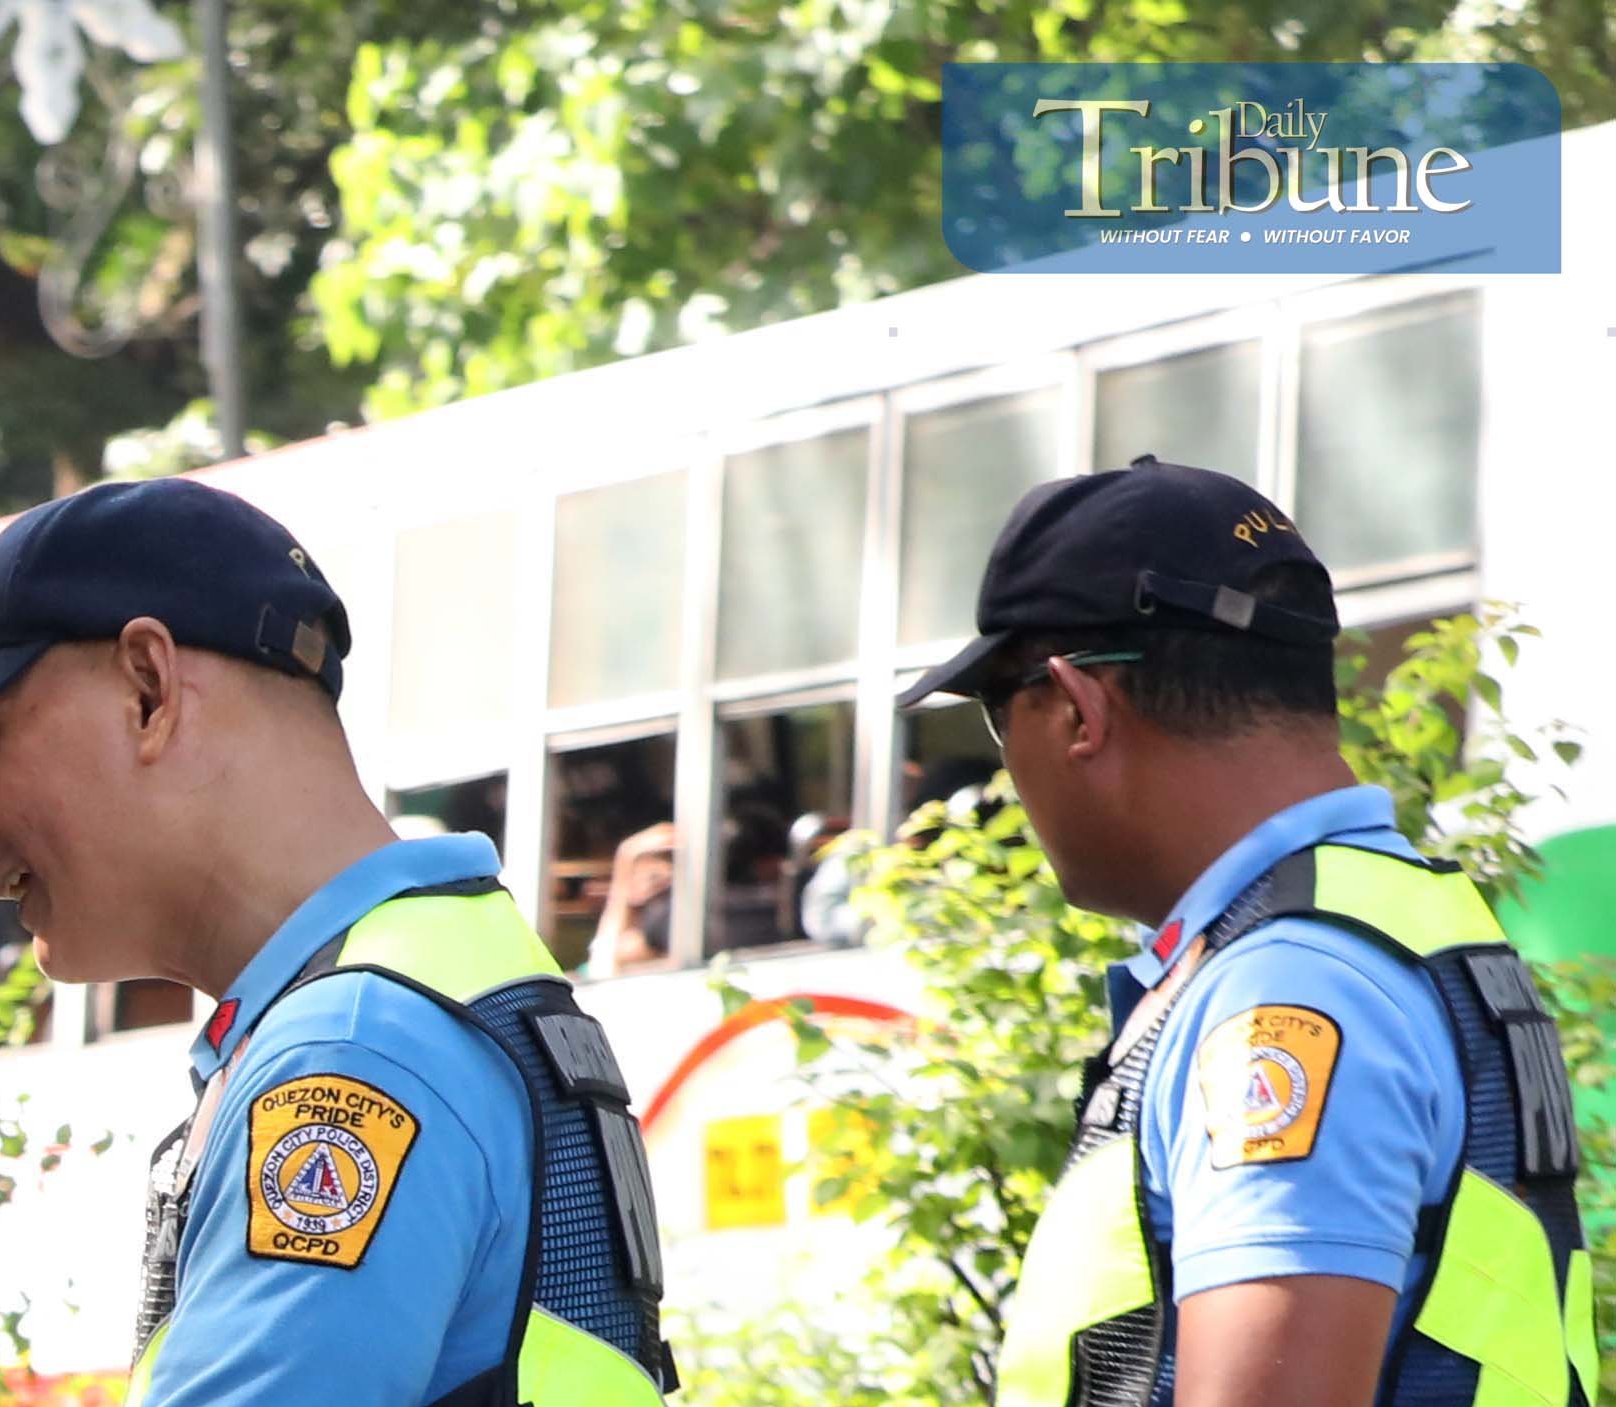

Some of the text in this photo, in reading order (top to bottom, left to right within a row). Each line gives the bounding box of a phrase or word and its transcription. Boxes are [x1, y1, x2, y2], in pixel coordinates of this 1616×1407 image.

[1234, 508, 1296, 548] PUL
[261, 1086, 405, 1129] QUEZON CITY'S
[294, 1104, 365, 1128] PRIDE
[263, 1152, 284, 1210] QUEZON
[282, 1127, 312, 1152] CITY
[316, 1127, 365, 1159] POLICE
[346, 1159, 375, 1224] DISTRICT
[272, 1232, 340, 1256] QCPD
